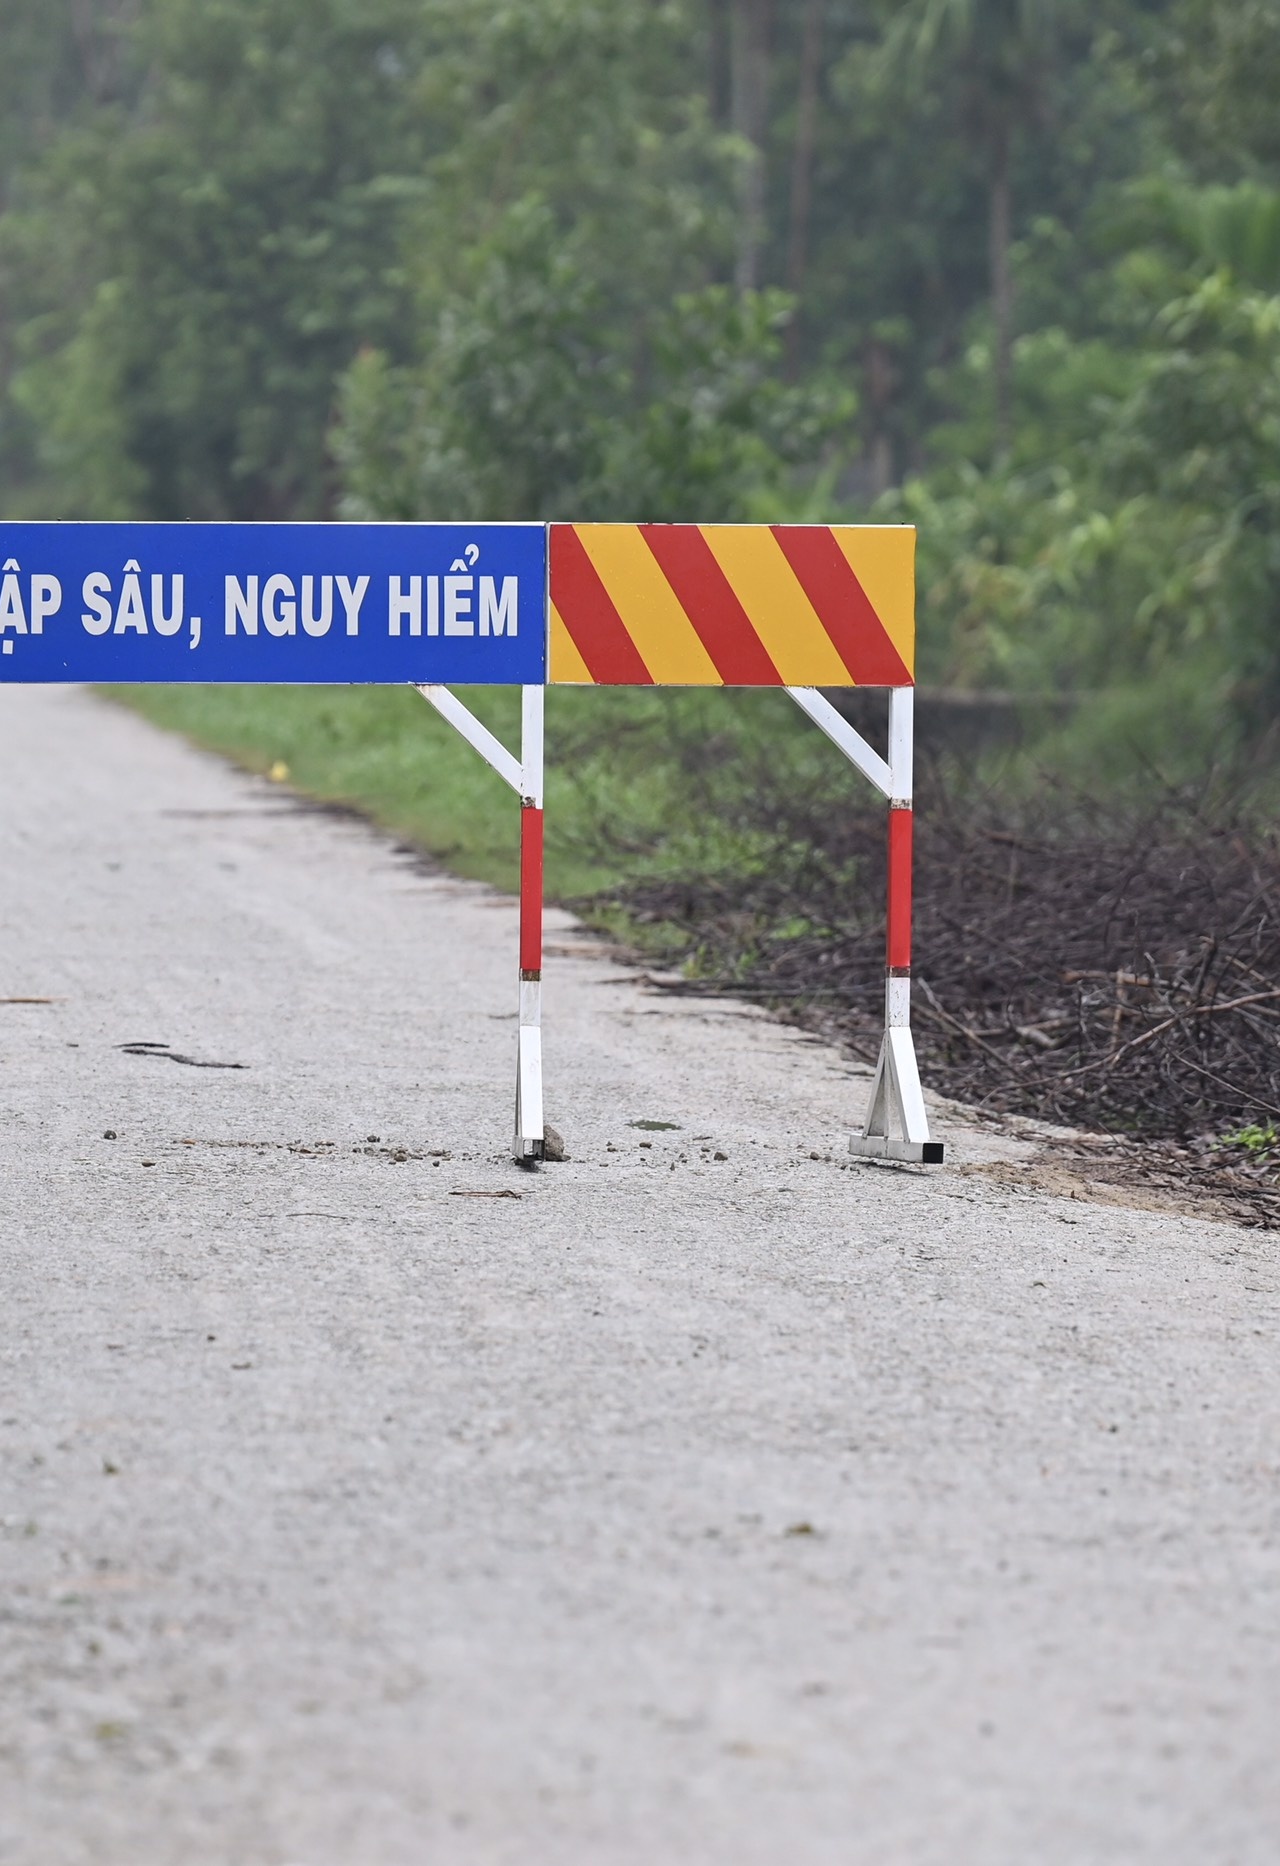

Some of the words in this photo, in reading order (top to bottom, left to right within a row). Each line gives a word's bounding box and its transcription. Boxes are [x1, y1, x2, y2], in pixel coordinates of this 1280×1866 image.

[81, 558, 202, 650] SÂU,
[224, 573, 371, 638] NGUY
[388, 543, 519, 637] HIỂM
